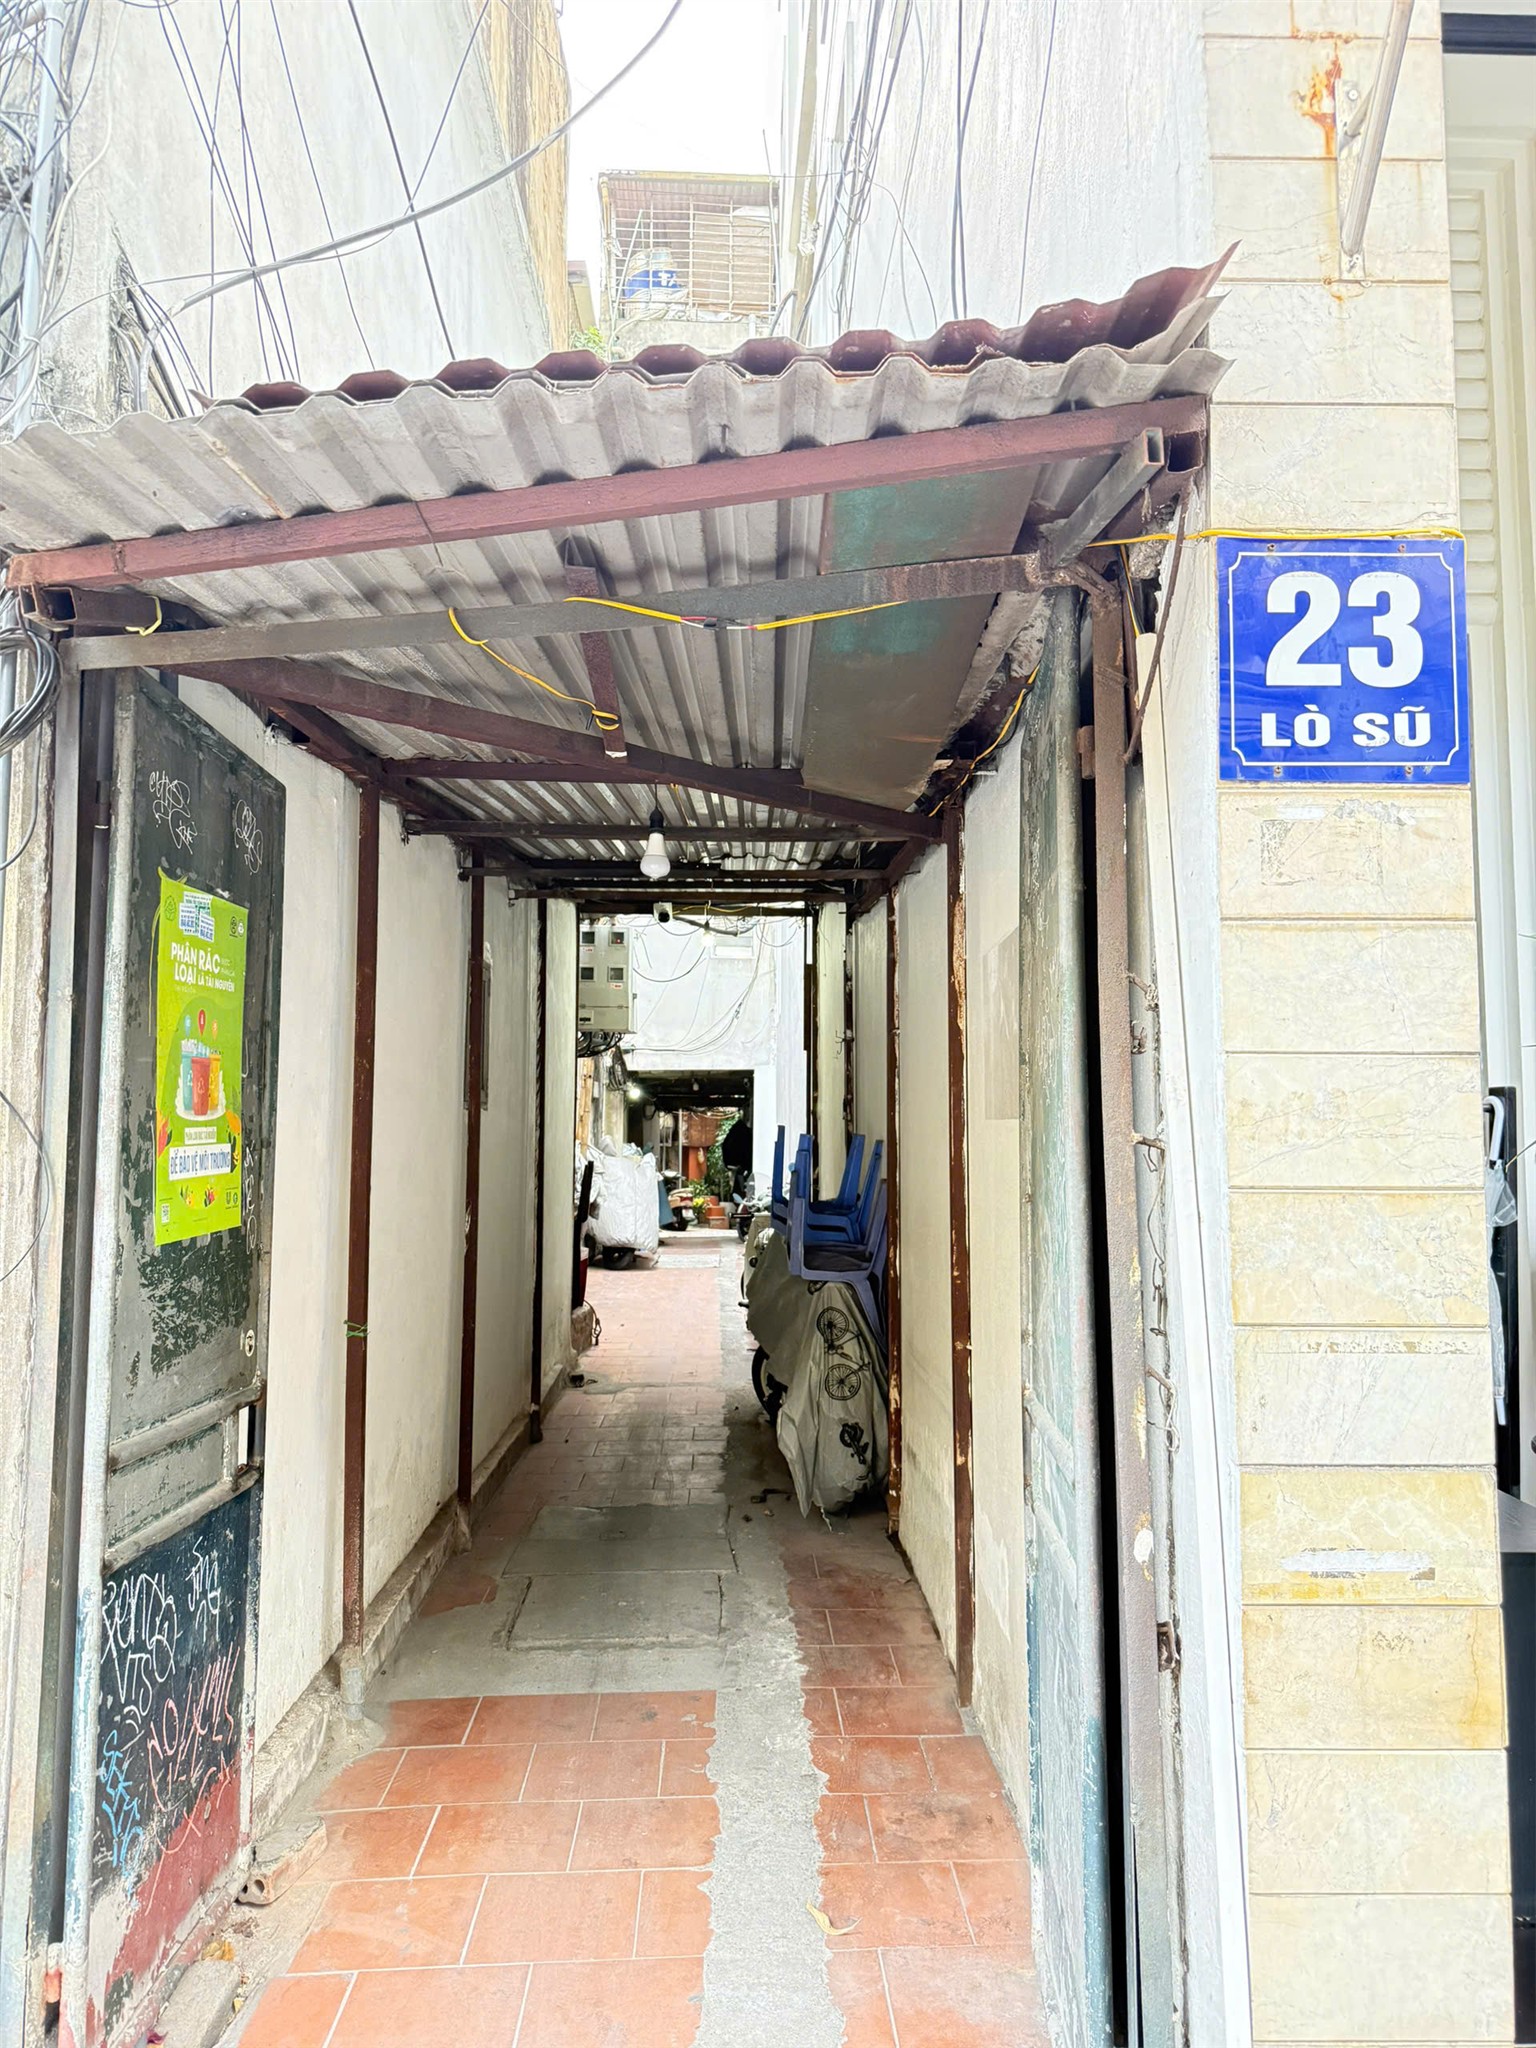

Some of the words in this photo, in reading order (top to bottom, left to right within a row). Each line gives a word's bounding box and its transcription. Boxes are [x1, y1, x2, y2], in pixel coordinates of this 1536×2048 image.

[1265, 570, 1424, 689] 23
[1261, 704, 1331, 748] LÒ
[1352, 705, 1432, 748] SŨ
[171, 942, 197, 965] PHÂN
[199, 947, 220, 974] RÁC
[174, 962, 197, 985] LOẠI
